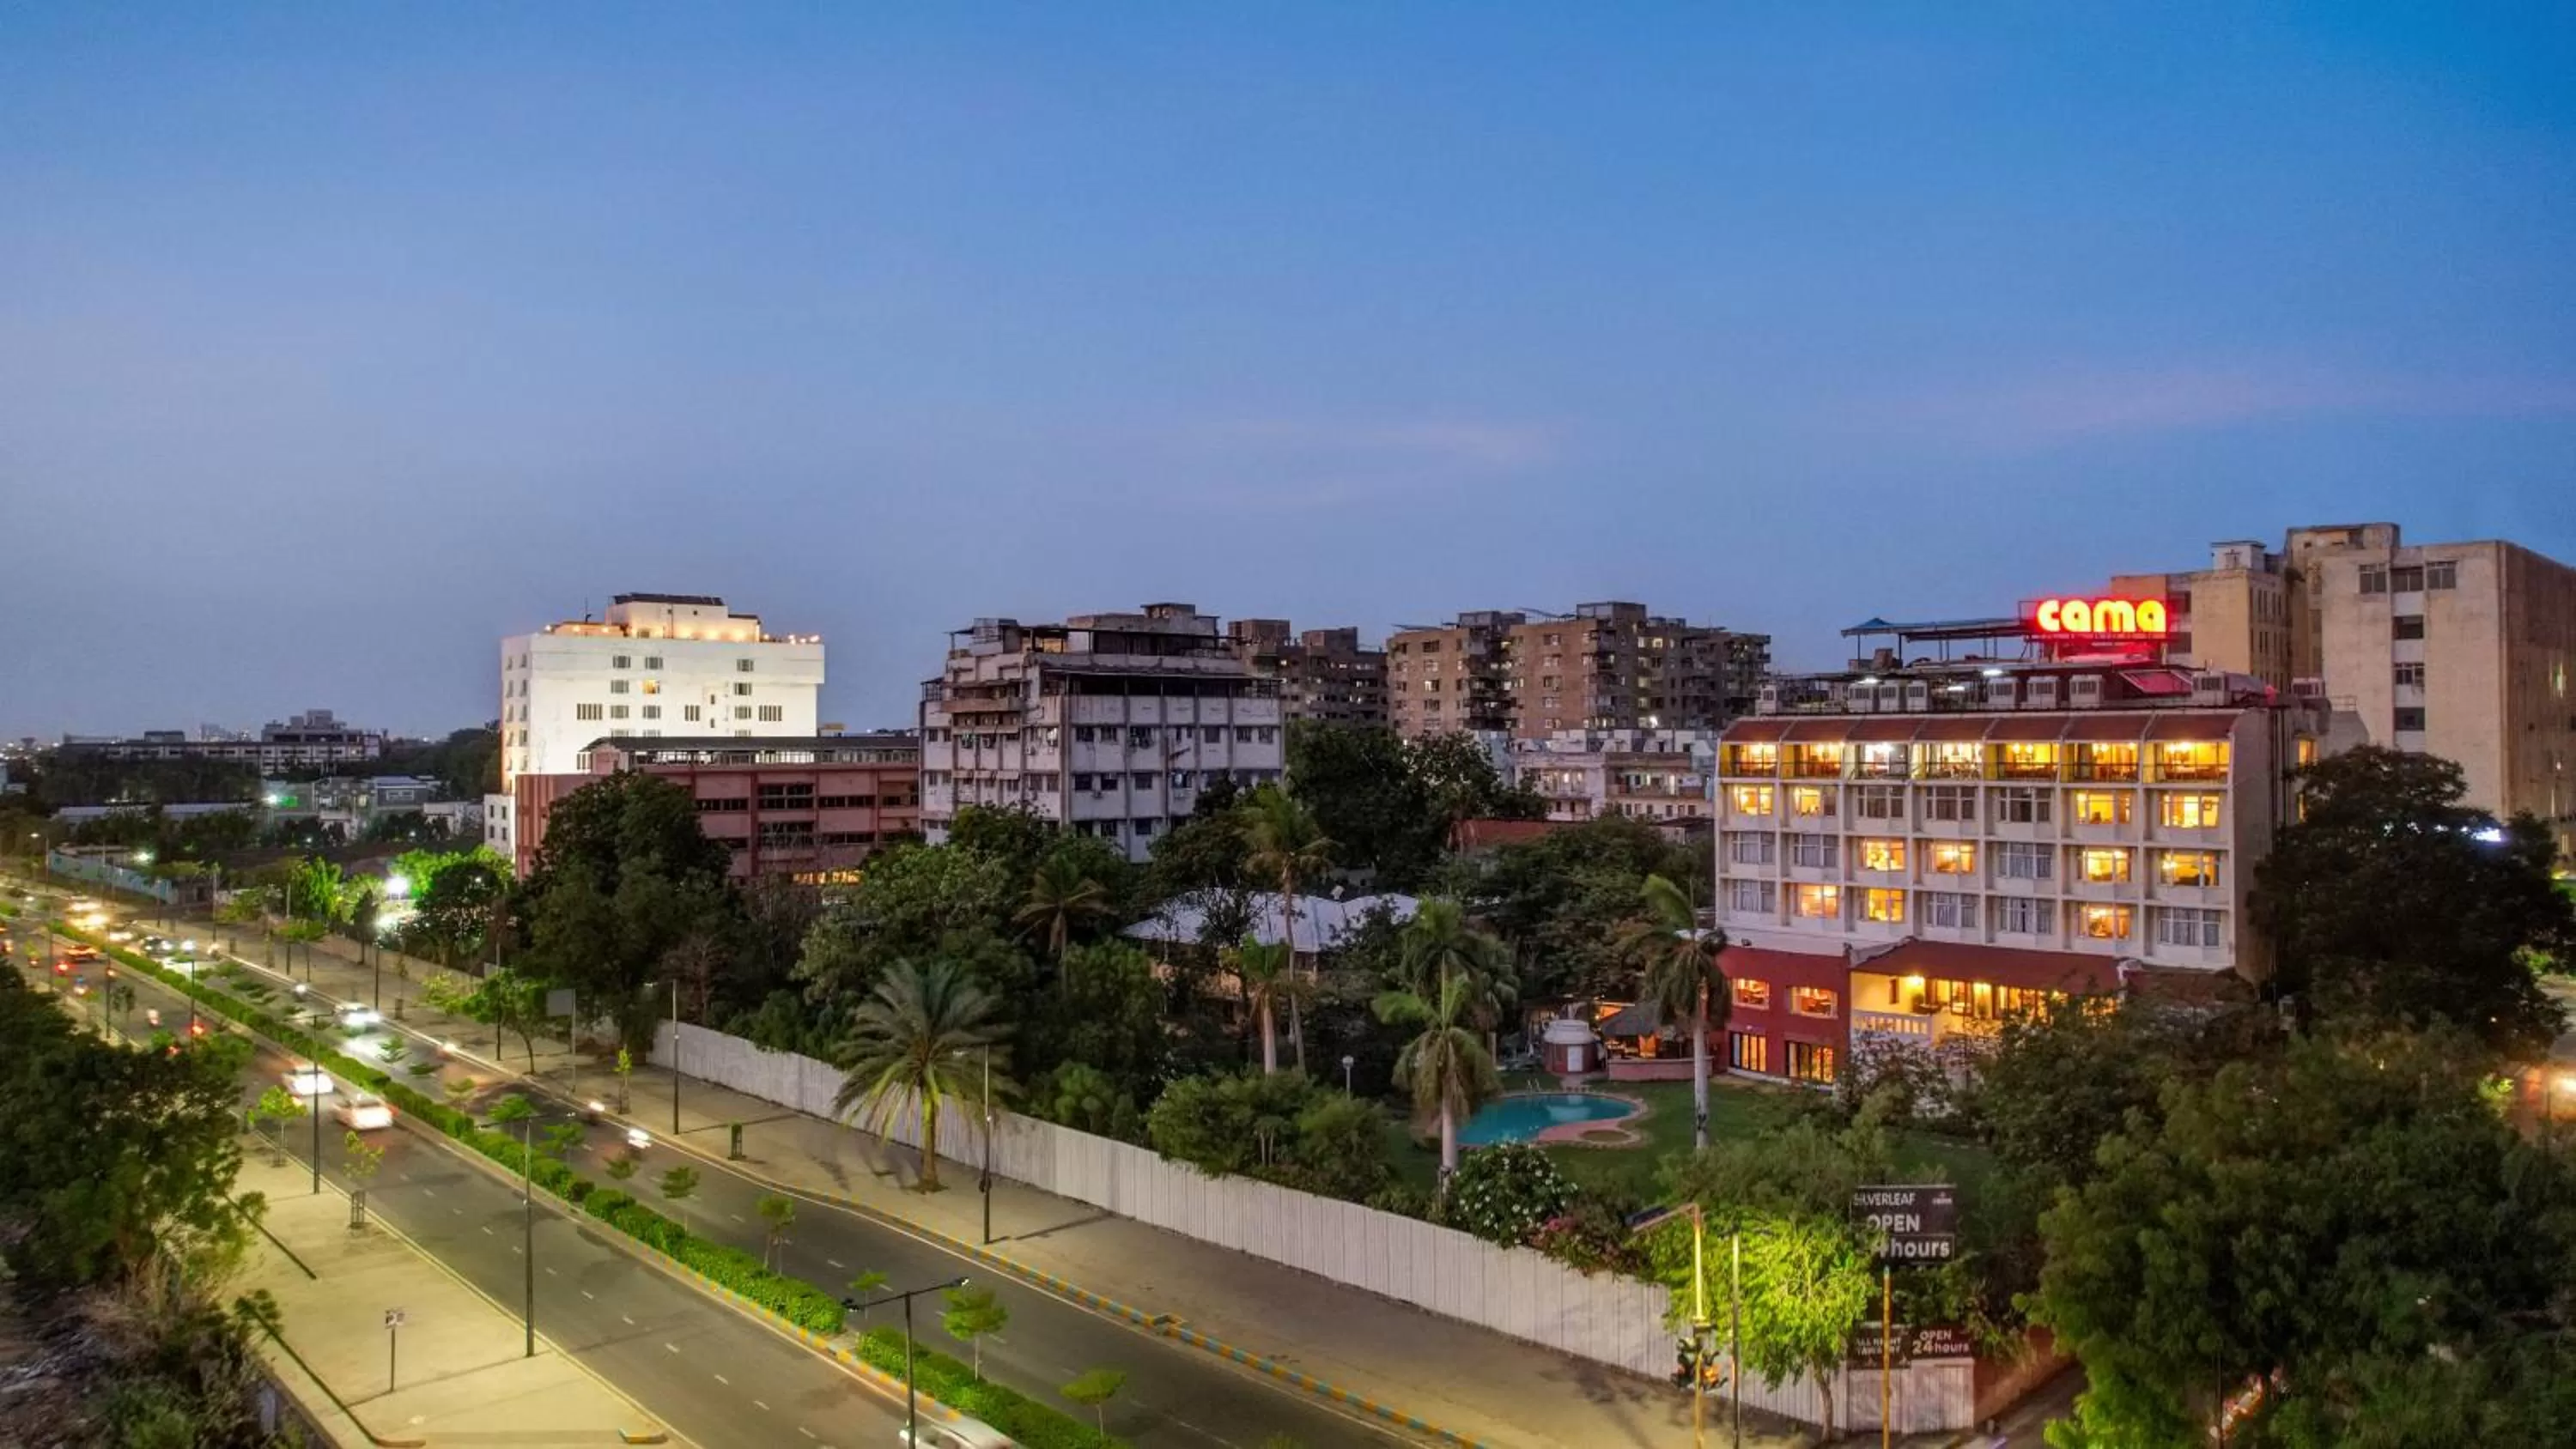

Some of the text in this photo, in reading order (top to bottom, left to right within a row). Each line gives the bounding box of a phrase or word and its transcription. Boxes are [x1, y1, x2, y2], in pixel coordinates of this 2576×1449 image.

[2037, 599, 2166, 633] cama
[1866, 1213, 1921, 1233] OPEN
[1919, 1329, 1952, 1341] OPEN
